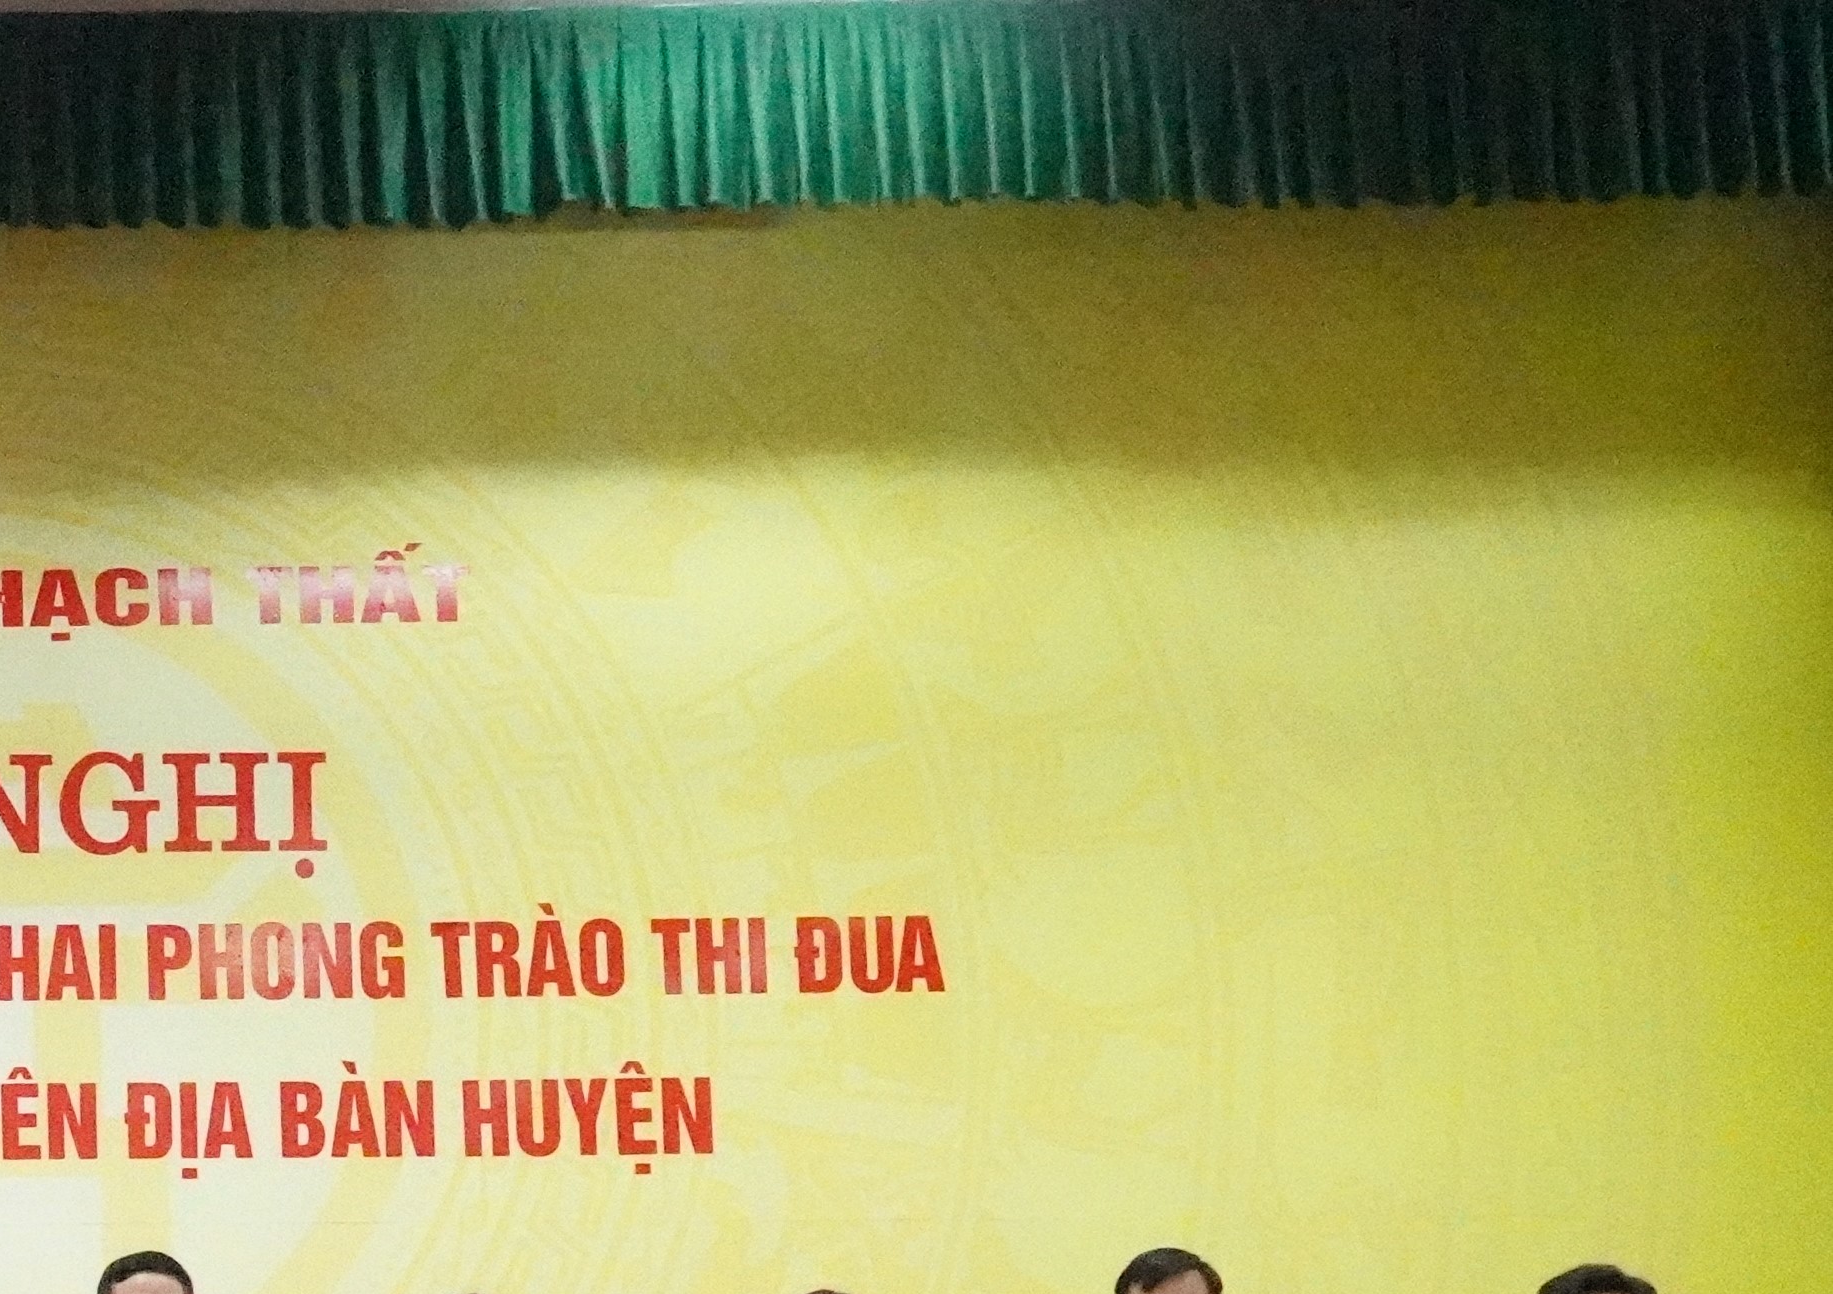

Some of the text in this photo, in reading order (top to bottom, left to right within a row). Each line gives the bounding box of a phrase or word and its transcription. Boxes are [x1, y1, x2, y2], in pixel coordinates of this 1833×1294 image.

[244, 542, 470, 624] THẤT
[145, 919, 408, 1001] PHONG
[428, 902, 628, 1000] TRÀO
[648, 917, 769, 997] THI
[793, 913, 947, 997] ĐUA
[123, 1080, 255, 1181] ĐỊA
[278, 1060, 437, 1159] BÀN
[460, 1060, 716, 1176] HUYỆN
